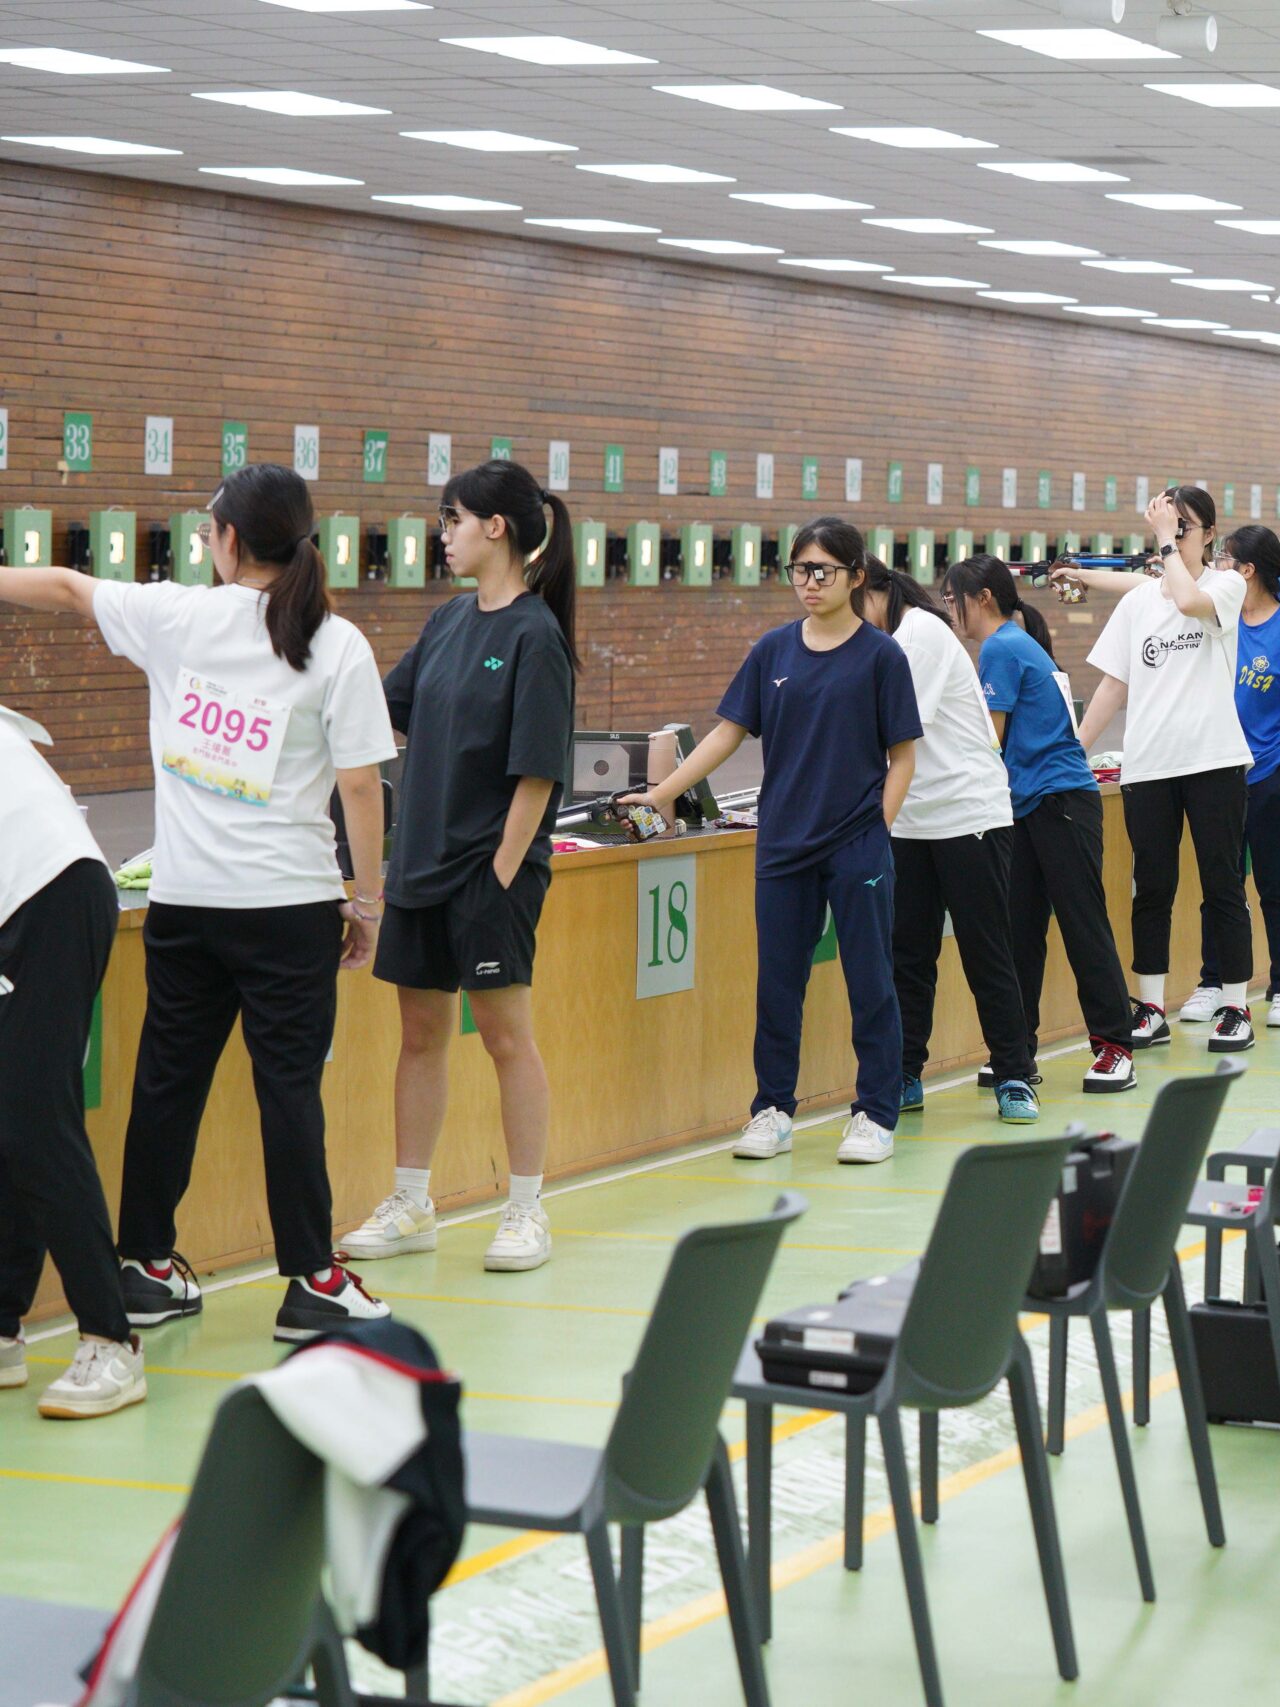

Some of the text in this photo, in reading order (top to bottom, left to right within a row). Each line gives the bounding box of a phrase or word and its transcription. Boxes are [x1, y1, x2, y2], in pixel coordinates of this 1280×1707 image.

[67, 424, 90, 460] 33
[147, 428, 169, 464] 34
[223, 432, 247, 467] 35
[298, 437, 317, 469] 36
[365, 440, 386, 472] 37
[430, 444, 449, 475] 38
[605, 454, 621, 483] 41
[178, 692, 273, 752] 2095
[647, 880, 689, 967] 18
